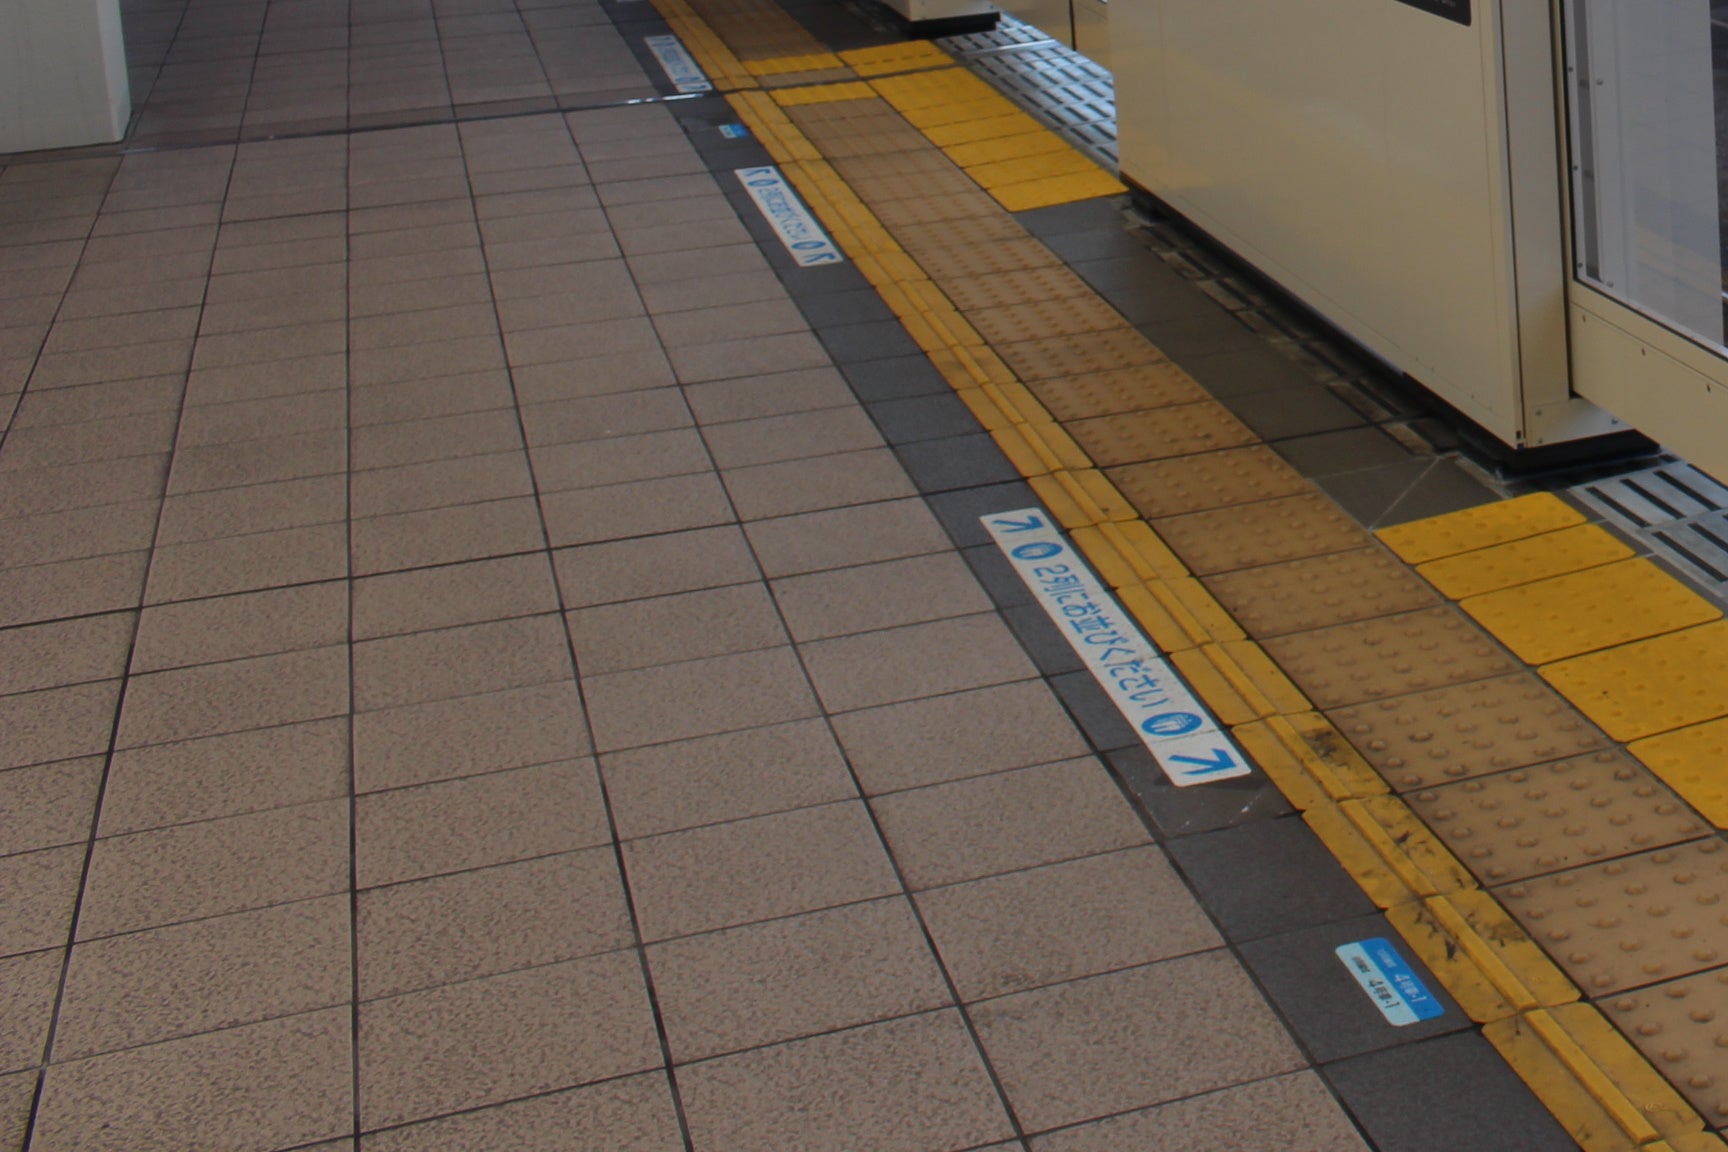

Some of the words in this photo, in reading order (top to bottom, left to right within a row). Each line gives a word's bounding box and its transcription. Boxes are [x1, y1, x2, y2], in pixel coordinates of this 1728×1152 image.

[1033, 562, 1170, 710] 2列にお並びください
